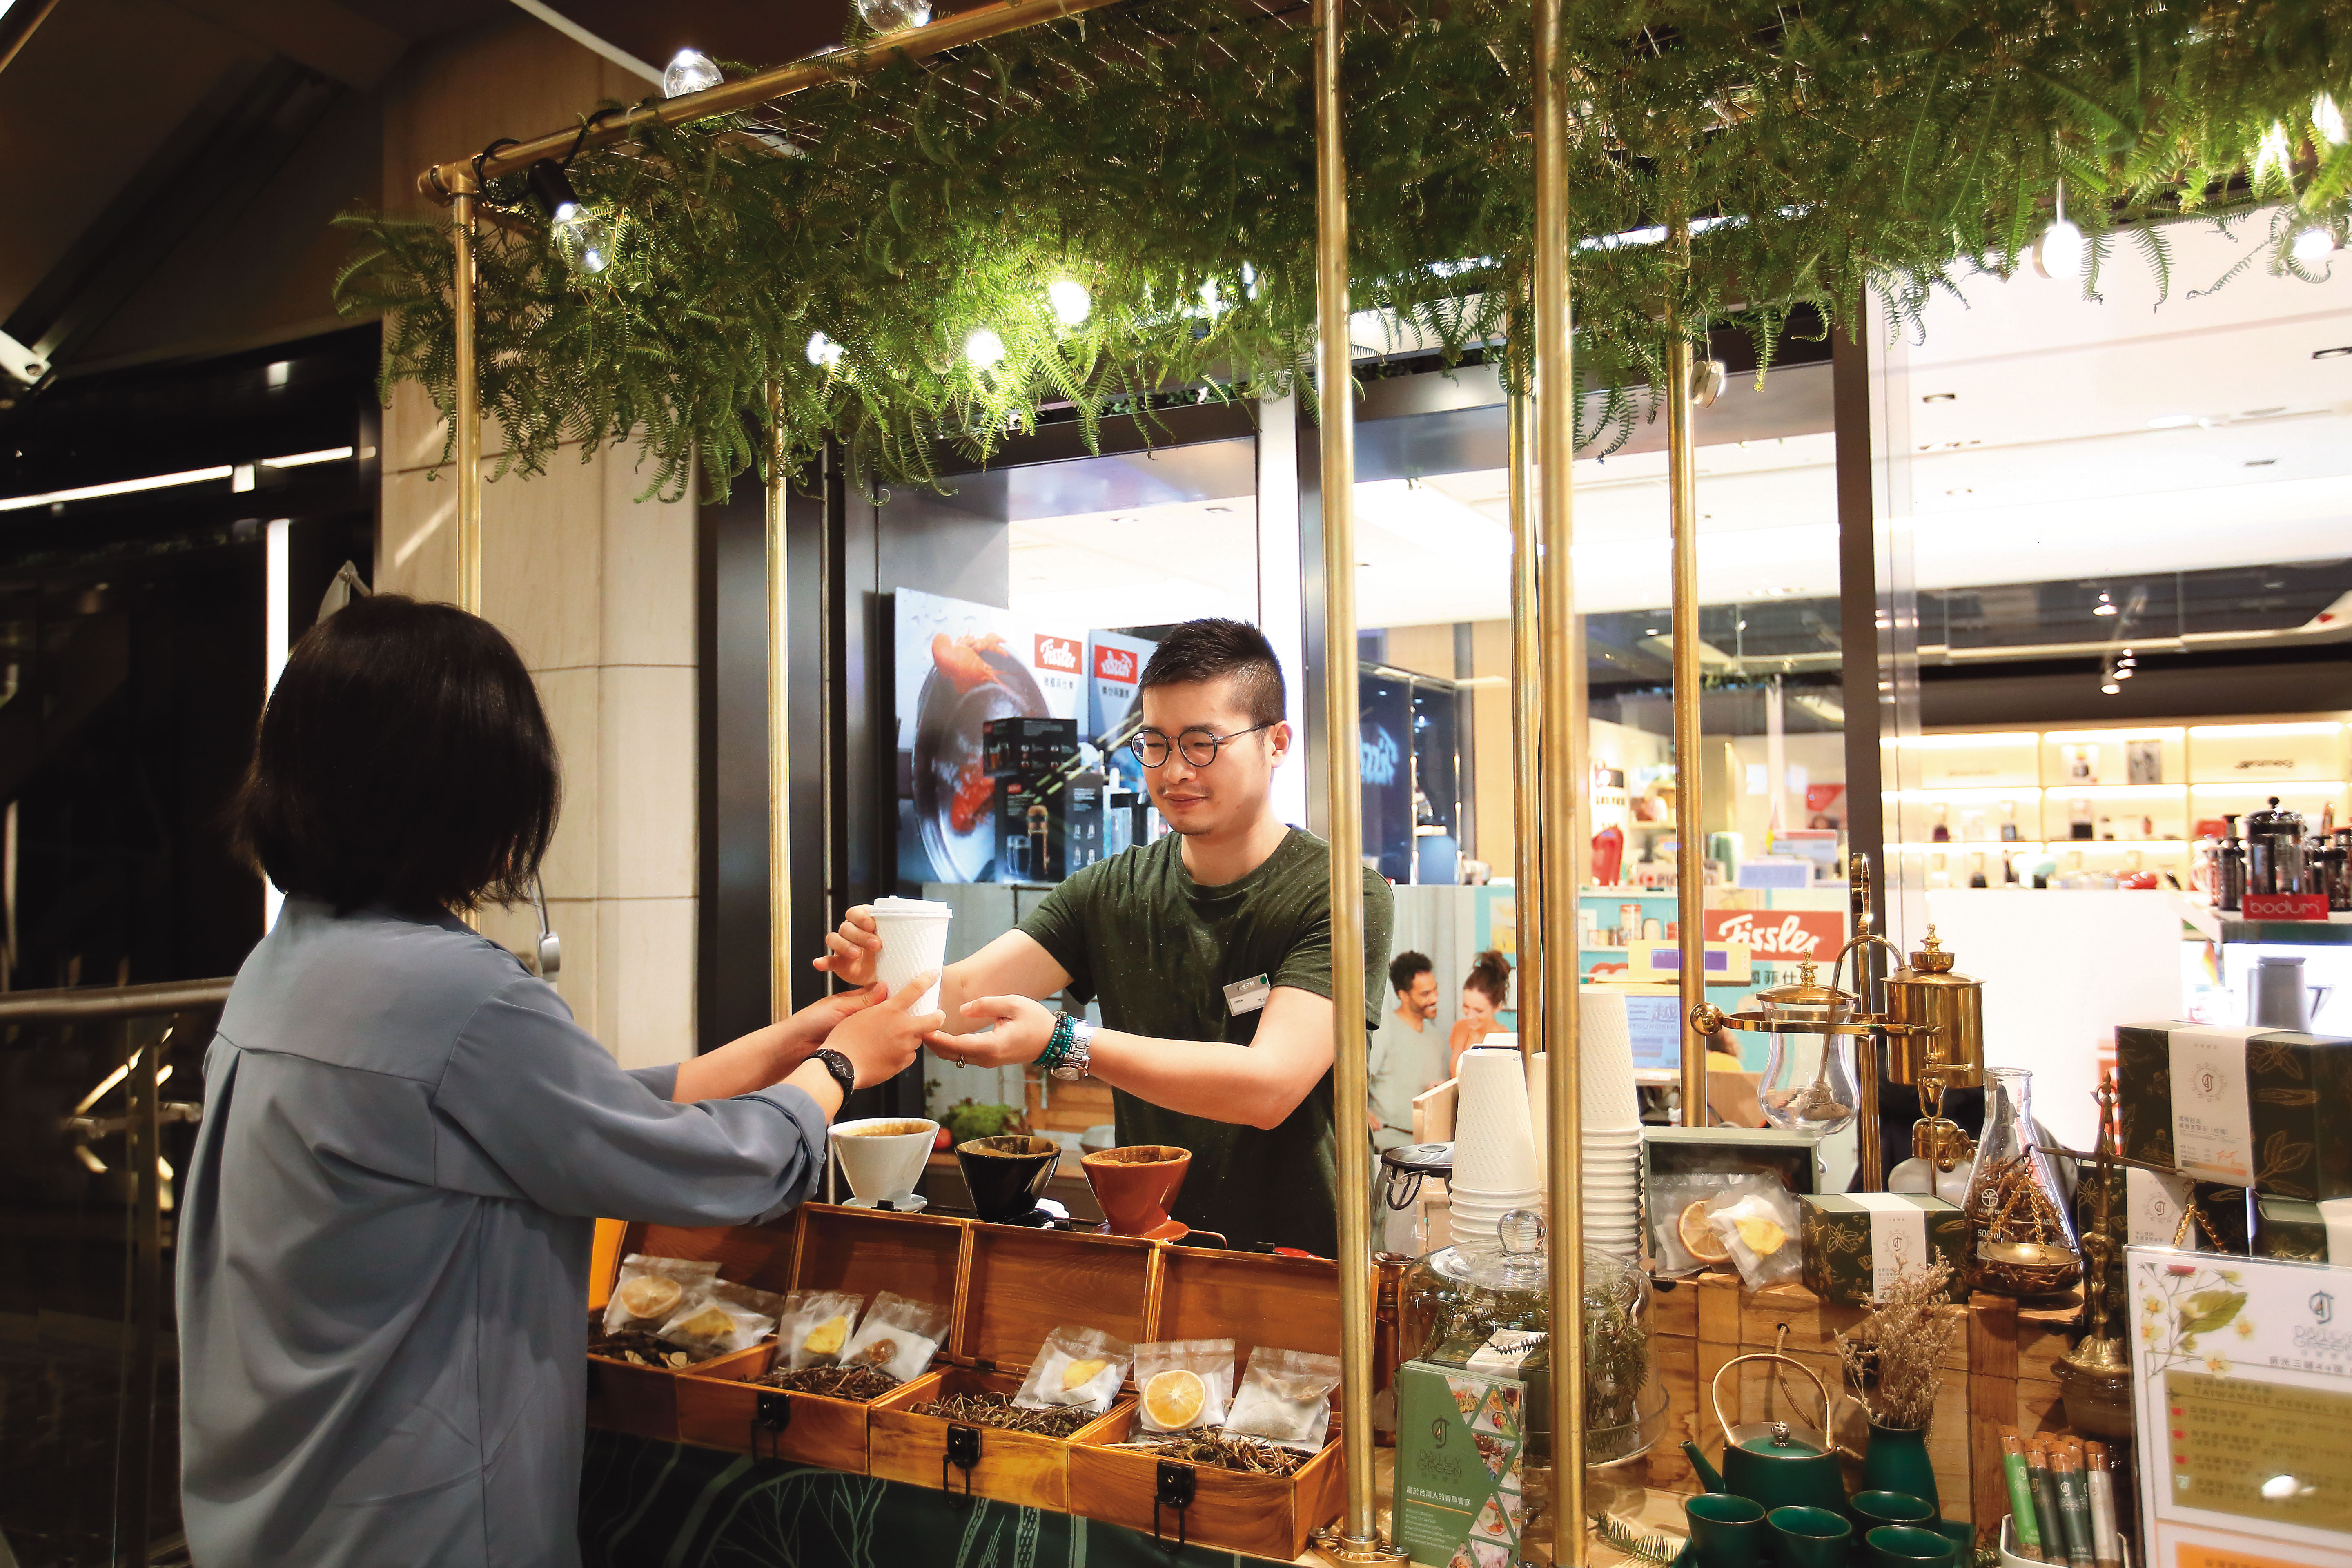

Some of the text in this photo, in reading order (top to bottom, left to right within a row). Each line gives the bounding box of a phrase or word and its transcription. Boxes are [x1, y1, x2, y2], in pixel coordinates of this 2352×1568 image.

[1040, 638, 1076, 668] Fissler
[2250, 900, 2320, 915] bodum
[1718, 913, 1819, 953] Fissler
[1419, 1449, 1463, 1467] DAILY
[1417, 1459, 1461, 1477] GREEN
